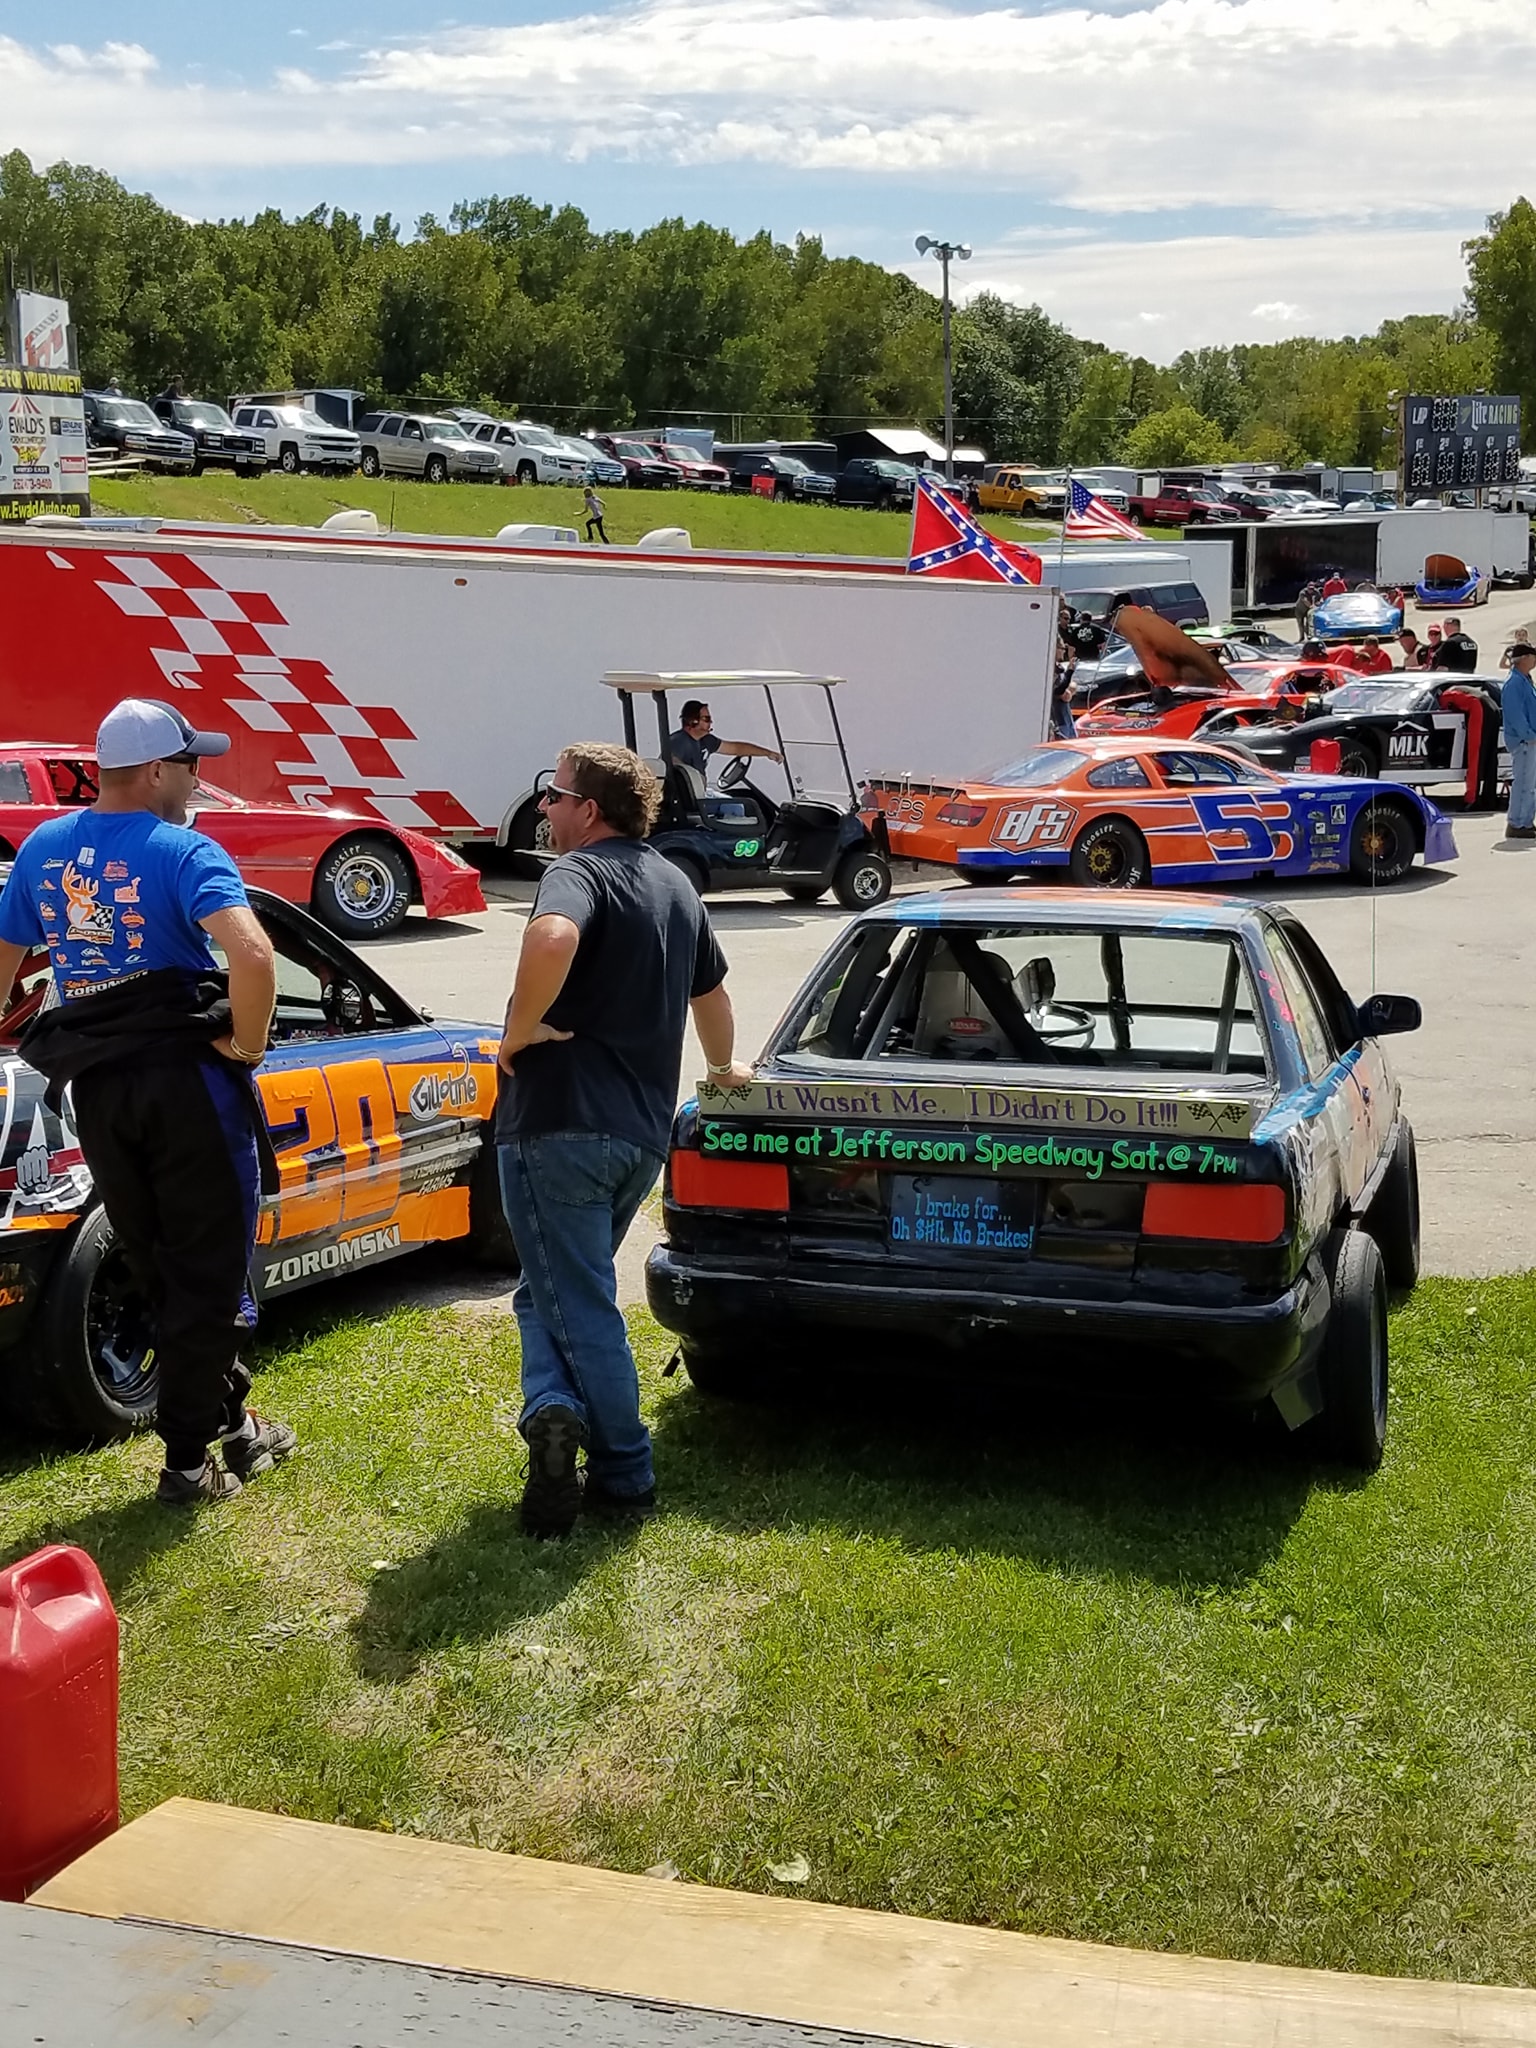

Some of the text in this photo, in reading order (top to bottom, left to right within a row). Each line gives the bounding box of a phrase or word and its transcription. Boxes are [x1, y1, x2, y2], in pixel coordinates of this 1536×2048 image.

[6, 370, 23, 389] FOR
[24, 371, 49, 391] YOUR
[1412, 407, 1428, 424] LAP
[1488, 405, 1518, 424] RACING
[1388, 735, 1430, 757] MLK
[886, 797, 926, 823] QPS
[996, 803, 1071, 846] BFS
[733, 839, 759, 857] 99
[1081, 824, 1114, 855] Hoosier
[325, 845, 361, 883] Hoosier
[373, 890, 409, 928] Hoosier
[65, 973, 148, 998] ZOROM
[764, 1086, 1178, 1127] It Wasn't Me. I Didn't Do It!!!
[703, 1122, 748, 1152] See
[753, 1133, 790, 1153] me
[795, 1127, 823, 1156] at
[828, 1127, 966, 1163] Jefferson
[974, 1134, 1104, 1180] Speedway
[914, 1193, 1012, 1221] I brake for...
[892, 1216, 911, 1241] Oh
[953, 1221, 972, 1245] No
[976, 1221, 1035, 1250] Brakes!
[263, 1224, 402, 1290] ZOROMSKI
